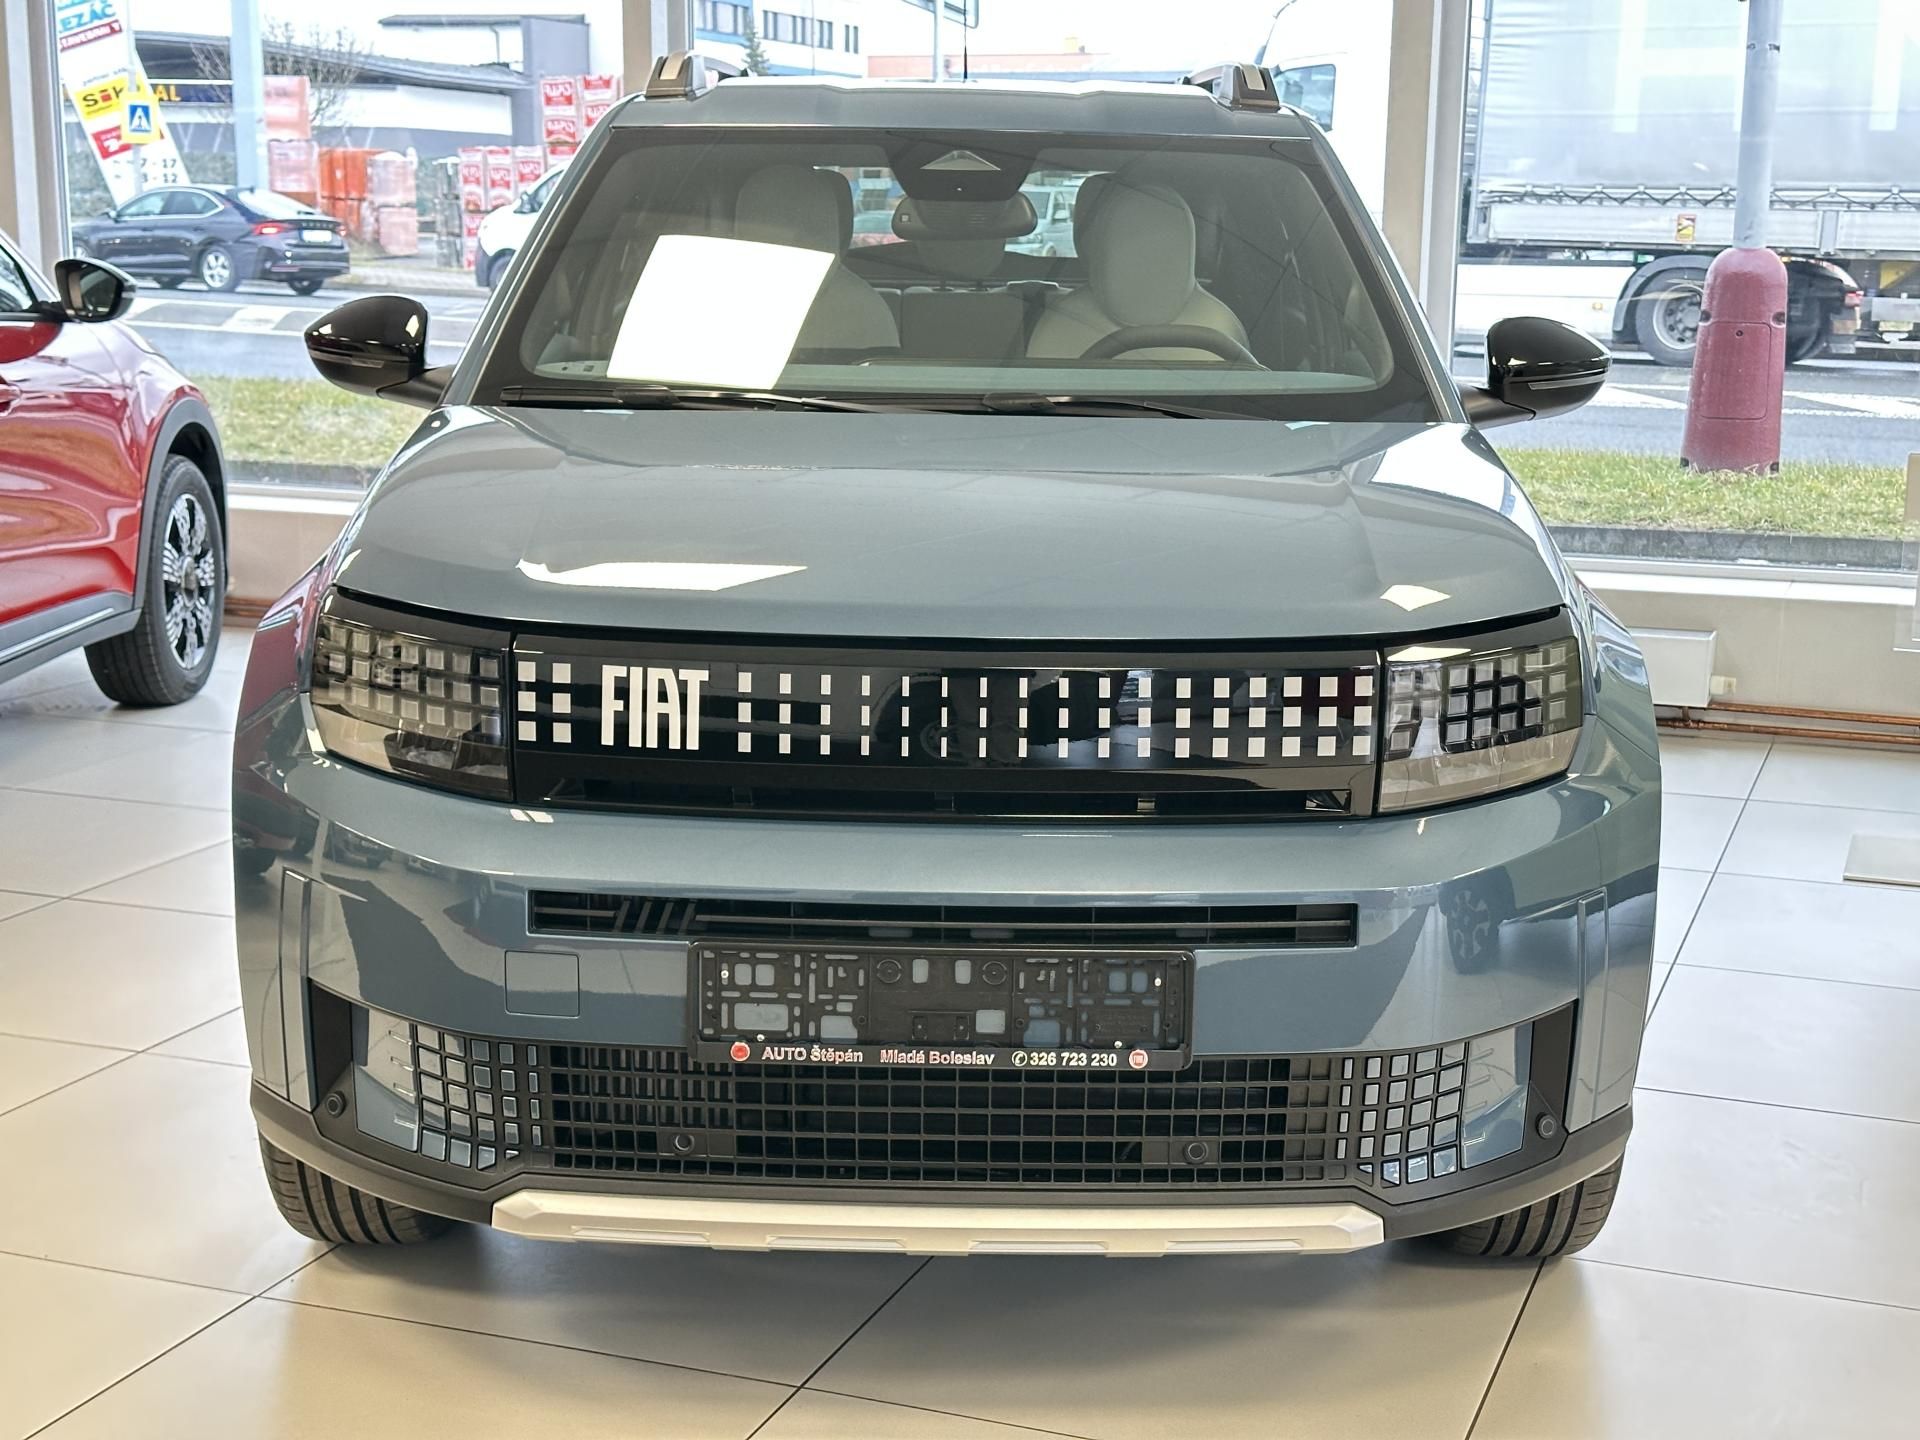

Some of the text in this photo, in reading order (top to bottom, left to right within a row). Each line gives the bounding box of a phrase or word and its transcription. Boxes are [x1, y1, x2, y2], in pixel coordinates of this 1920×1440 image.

[601, 664, 709, 750] FIAT
[761, 1046, 807, 1061] AUTO
[810, 1045, 863, 1064] Štěpán
[880, 1049, 925, 1064] Mladá
[929, 1050, 995, 1066] Boleslav
[1029, 1051, 1057, 1066] 326
[1061, 1052, 1087, 1067] 723
[1091, 1053, 1118, 1068] 230
